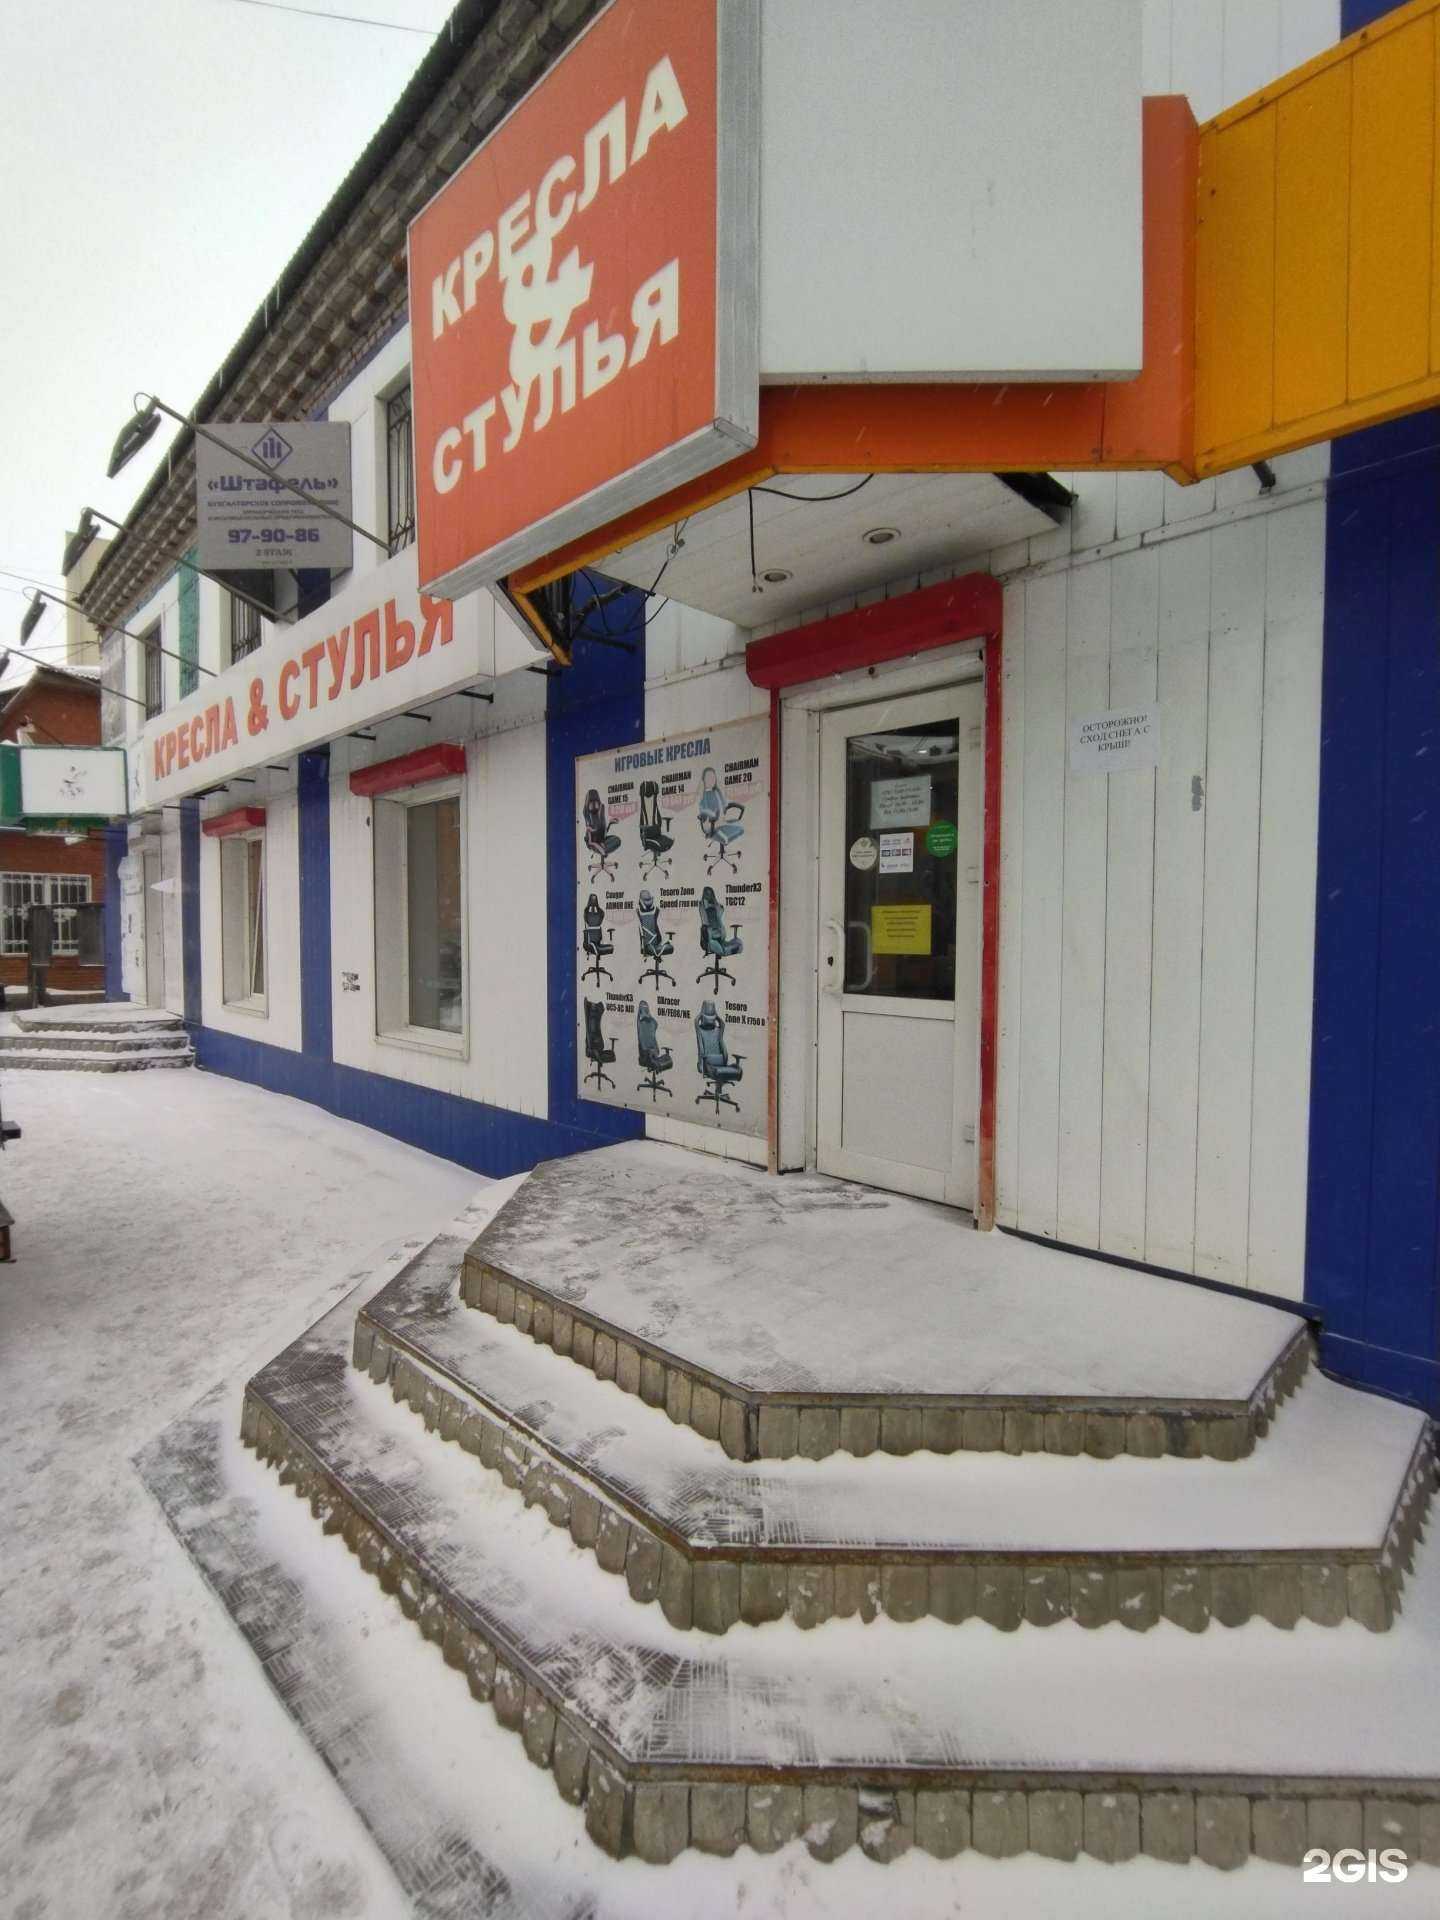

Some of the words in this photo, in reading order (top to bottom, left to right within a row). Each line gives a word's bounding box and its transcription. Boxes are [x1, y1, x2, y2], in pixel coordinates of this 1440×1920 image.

[432, 55, 688, 341] КРЕСЛА
[432, 258, 679, 494] СТУЛЬЯ
[228, 528, 320, 543] 97-90-86
[153, 696, 238, 781] КРЕСЛА
[247, 678, 269, 735] &
[279, 595, 453, 720] СТУЛЬЯ
[1082, 714, 1148, 733] ОСТОРОЖНО!
[1080, 732, 1107, 744] СХОД
[1109, 727, 1141, 739] СНЕГА
[615, 748, 663, 773] ИГРОВЫЕ
[665, 738, 711, 762] КРЕСЛА
[724, 758, 759, 773] CHAIRMAN
[661, 771, 692, 784] CHAIRMAN
[724, 773, 742, 786] GAME
[743, 772, 752, 783] 20
[725, 1000, 748, 1012] Tesoro
